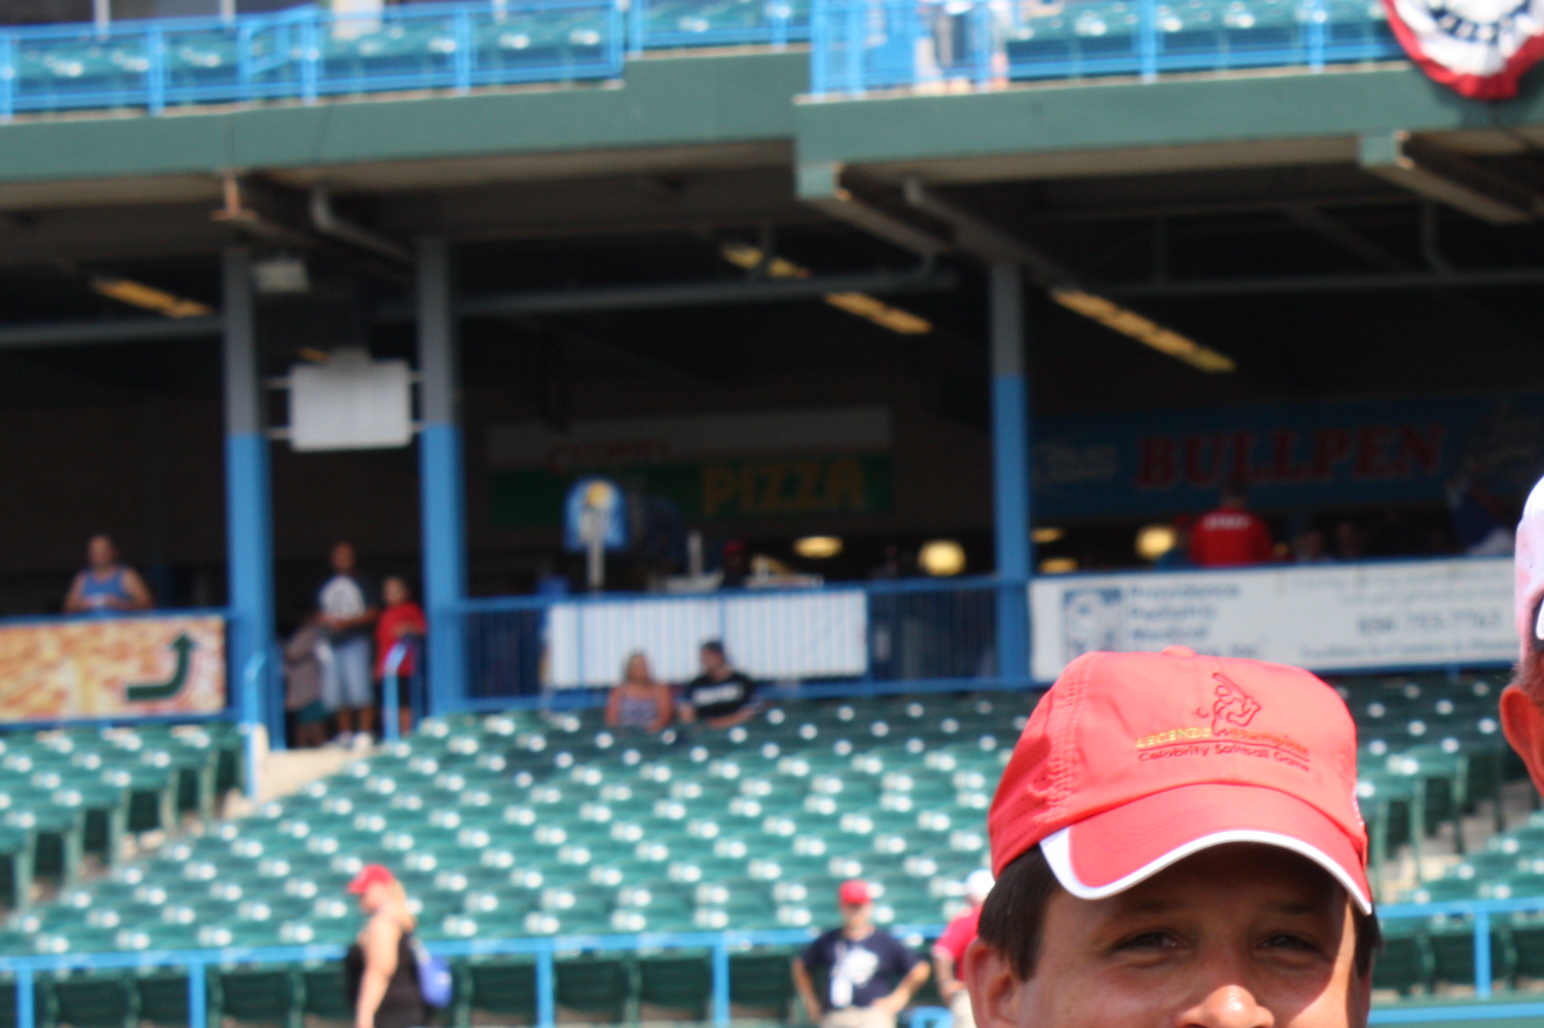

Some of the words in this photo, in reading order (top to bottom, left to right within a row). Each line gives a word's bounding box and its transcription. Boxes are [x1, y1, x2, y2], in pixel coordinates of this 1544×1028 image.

[1133, 421, 1447, 492] BULLPEN
[700, 457, 866, 518] PIZZA
[1134, 726, 1212, 749] LEGENDS
[1138, 744, 1210, 762] Celebrity
[1214, 743, 1270, 760] Softball
